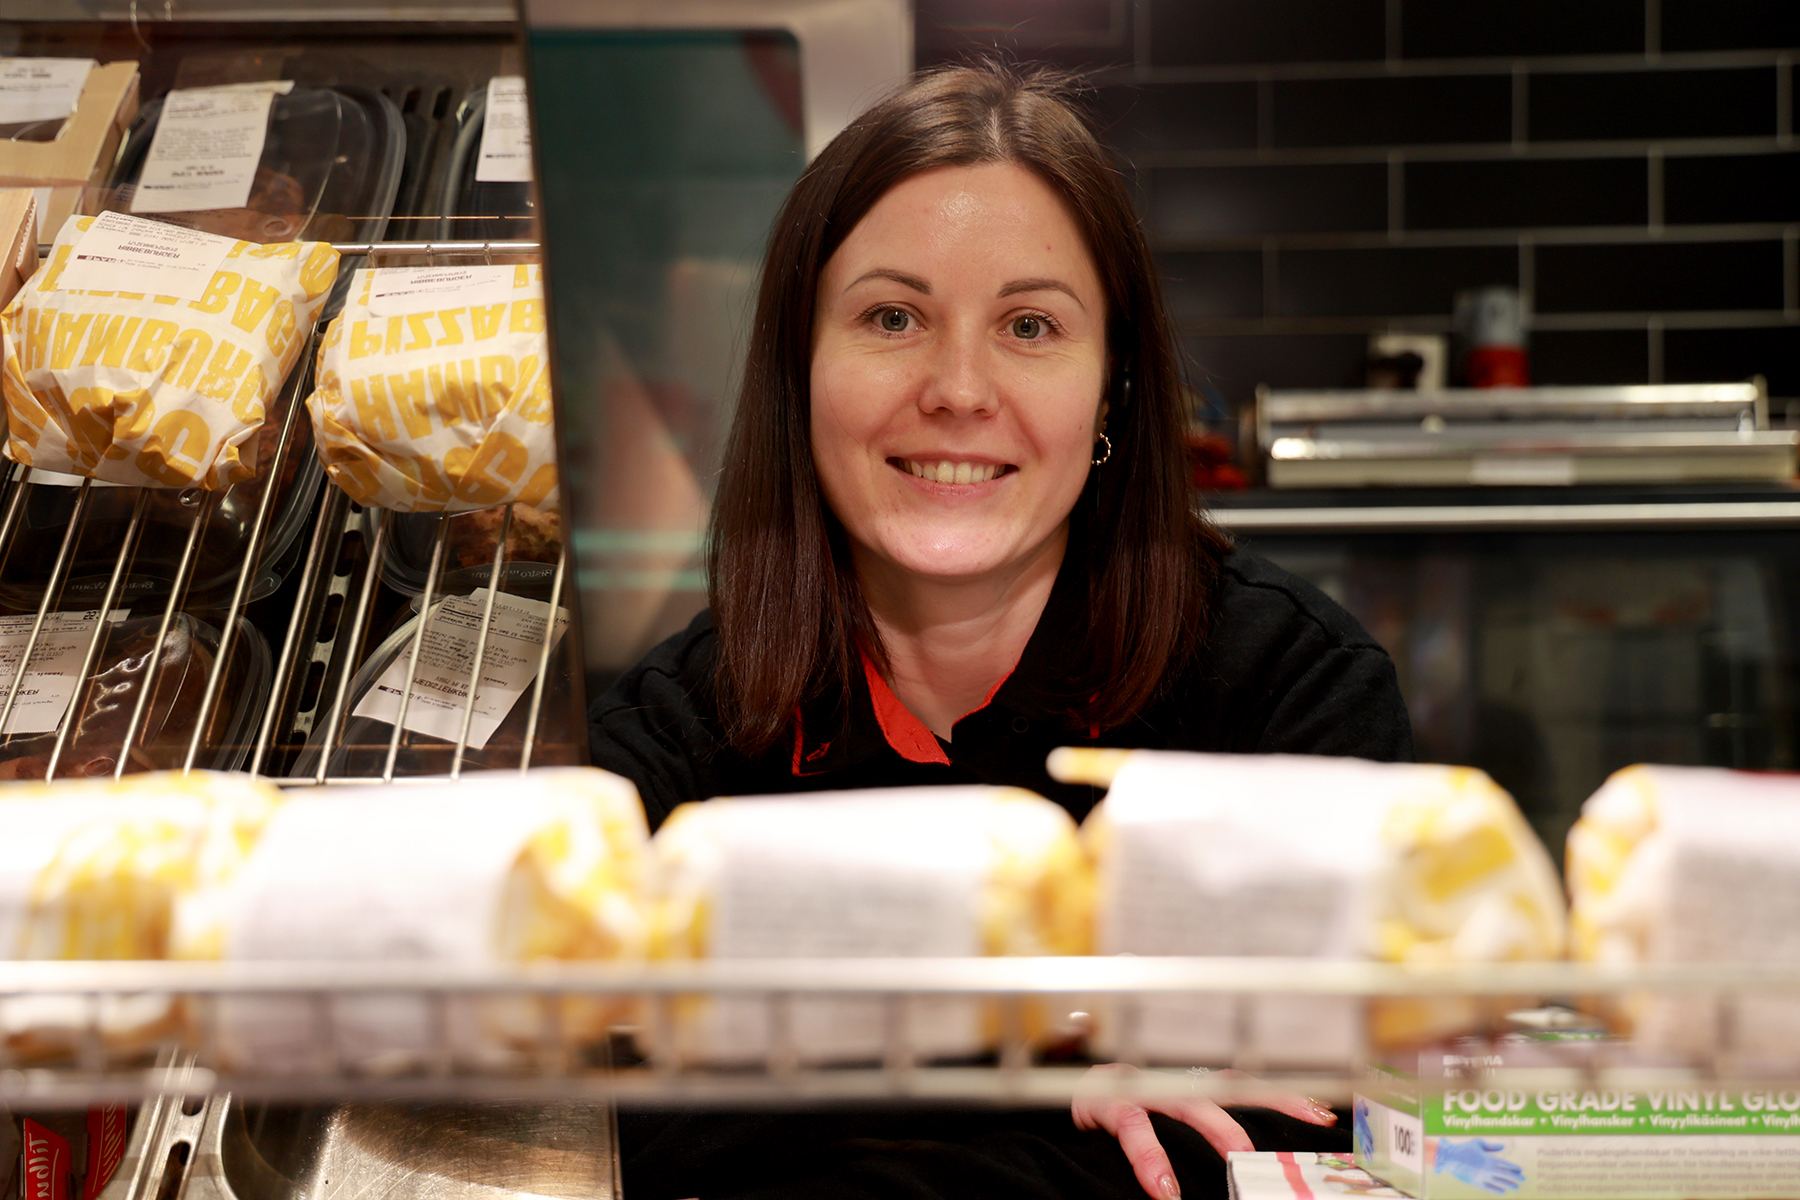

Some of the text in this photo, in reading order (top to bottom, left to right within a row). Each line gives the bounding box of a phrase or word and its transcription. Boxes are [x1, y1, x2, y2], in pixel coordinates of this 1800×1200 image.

[1443, 1089, 1800, 1112] FOOD GRADE VINYL GLO
[1443, 1114, 1536, 1129] Vinylhandskar
[1551, 1114, 1635, 1129] Vinylhansker
[1650, 1114, 1747, 1130] Vinyylikäsineet
